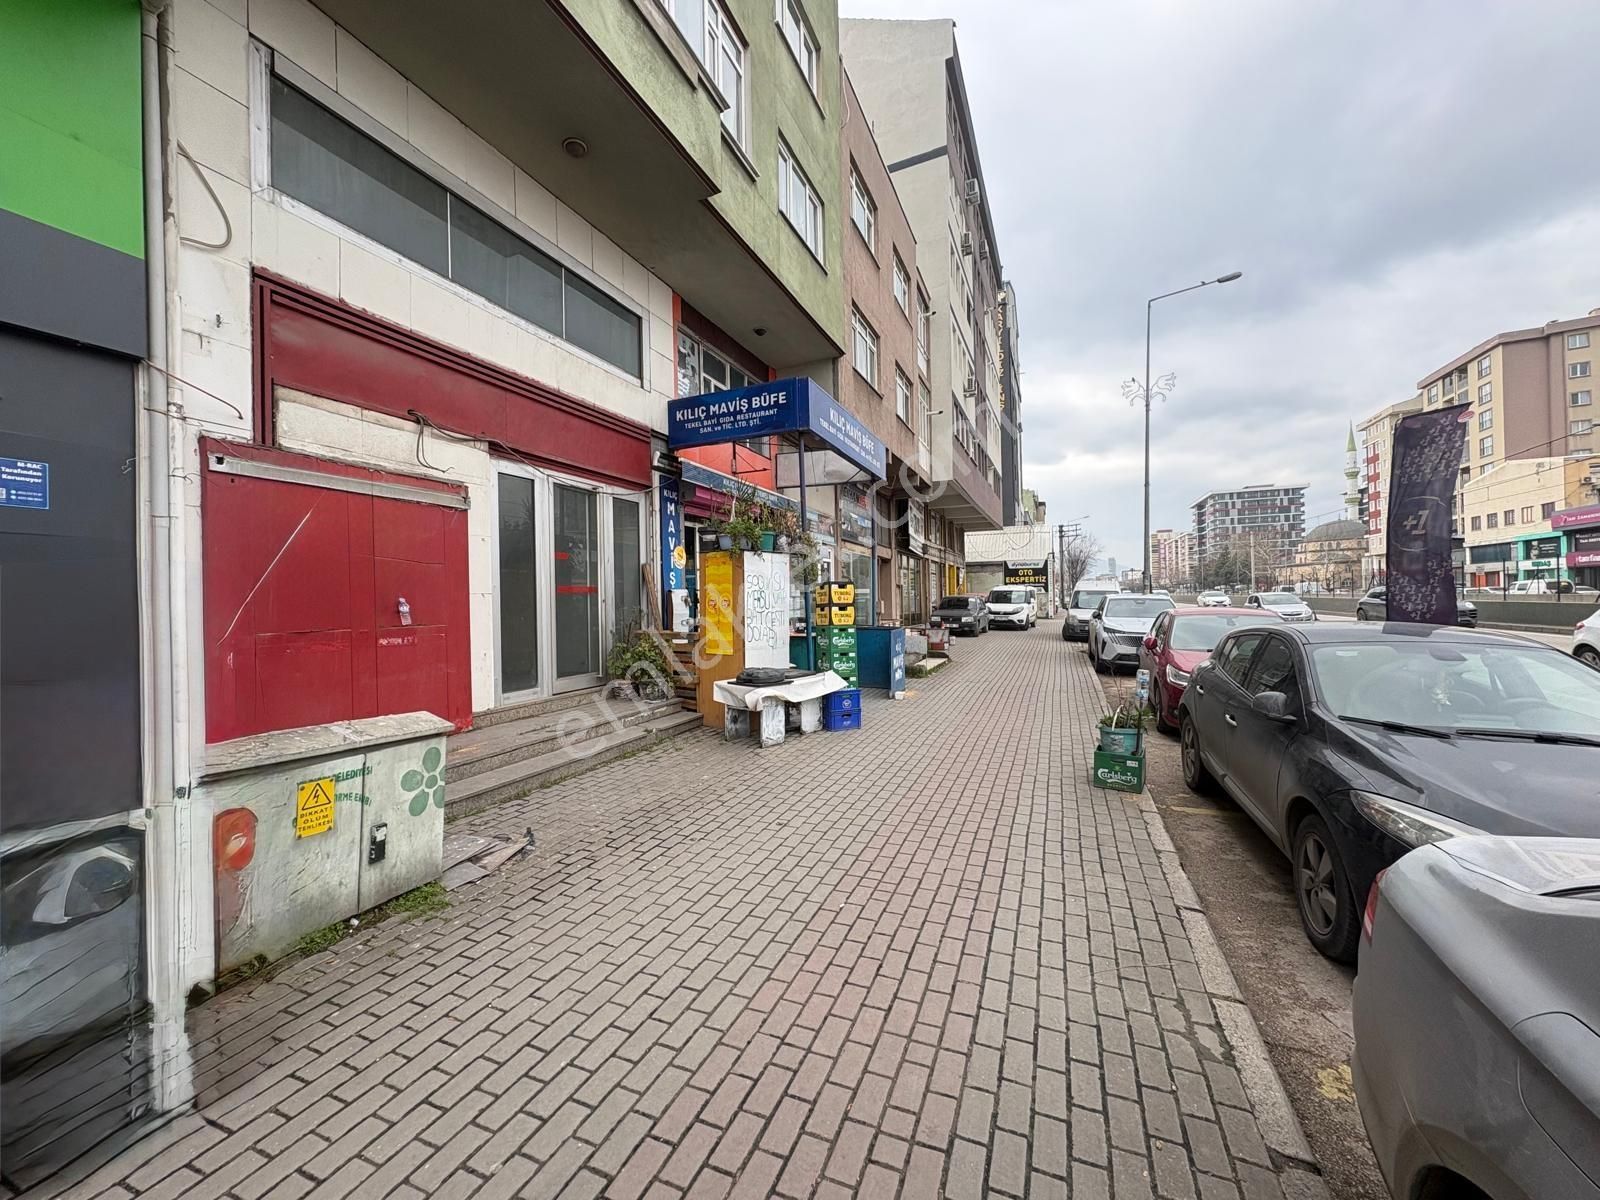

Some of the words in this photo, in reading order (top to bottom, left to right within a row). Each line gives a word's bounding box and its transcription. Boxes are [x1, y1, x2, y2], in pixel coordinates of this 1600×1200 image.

[676, 406, 706, 421] KILIÇ
[710, 397, 748, 415] MAVİŞ
[752, 392, 787, 409] BÜFE
[685, 421, 702, 429] TEKEL
[704, 417, 717, 427] BAYİ
[720, 416, 734, 424] GIDA
[737, 408, 777, 421] RESTAURANT
[1402, 510, 1429, 535] +1
[1005, 574, 1047, 584] EKSPERTİZ
[832, 636, 855, 646] Carlsberg
[833, 660, 856, 670] Carlsberg
[1097, 768, 1137, 786] Carlsberg
